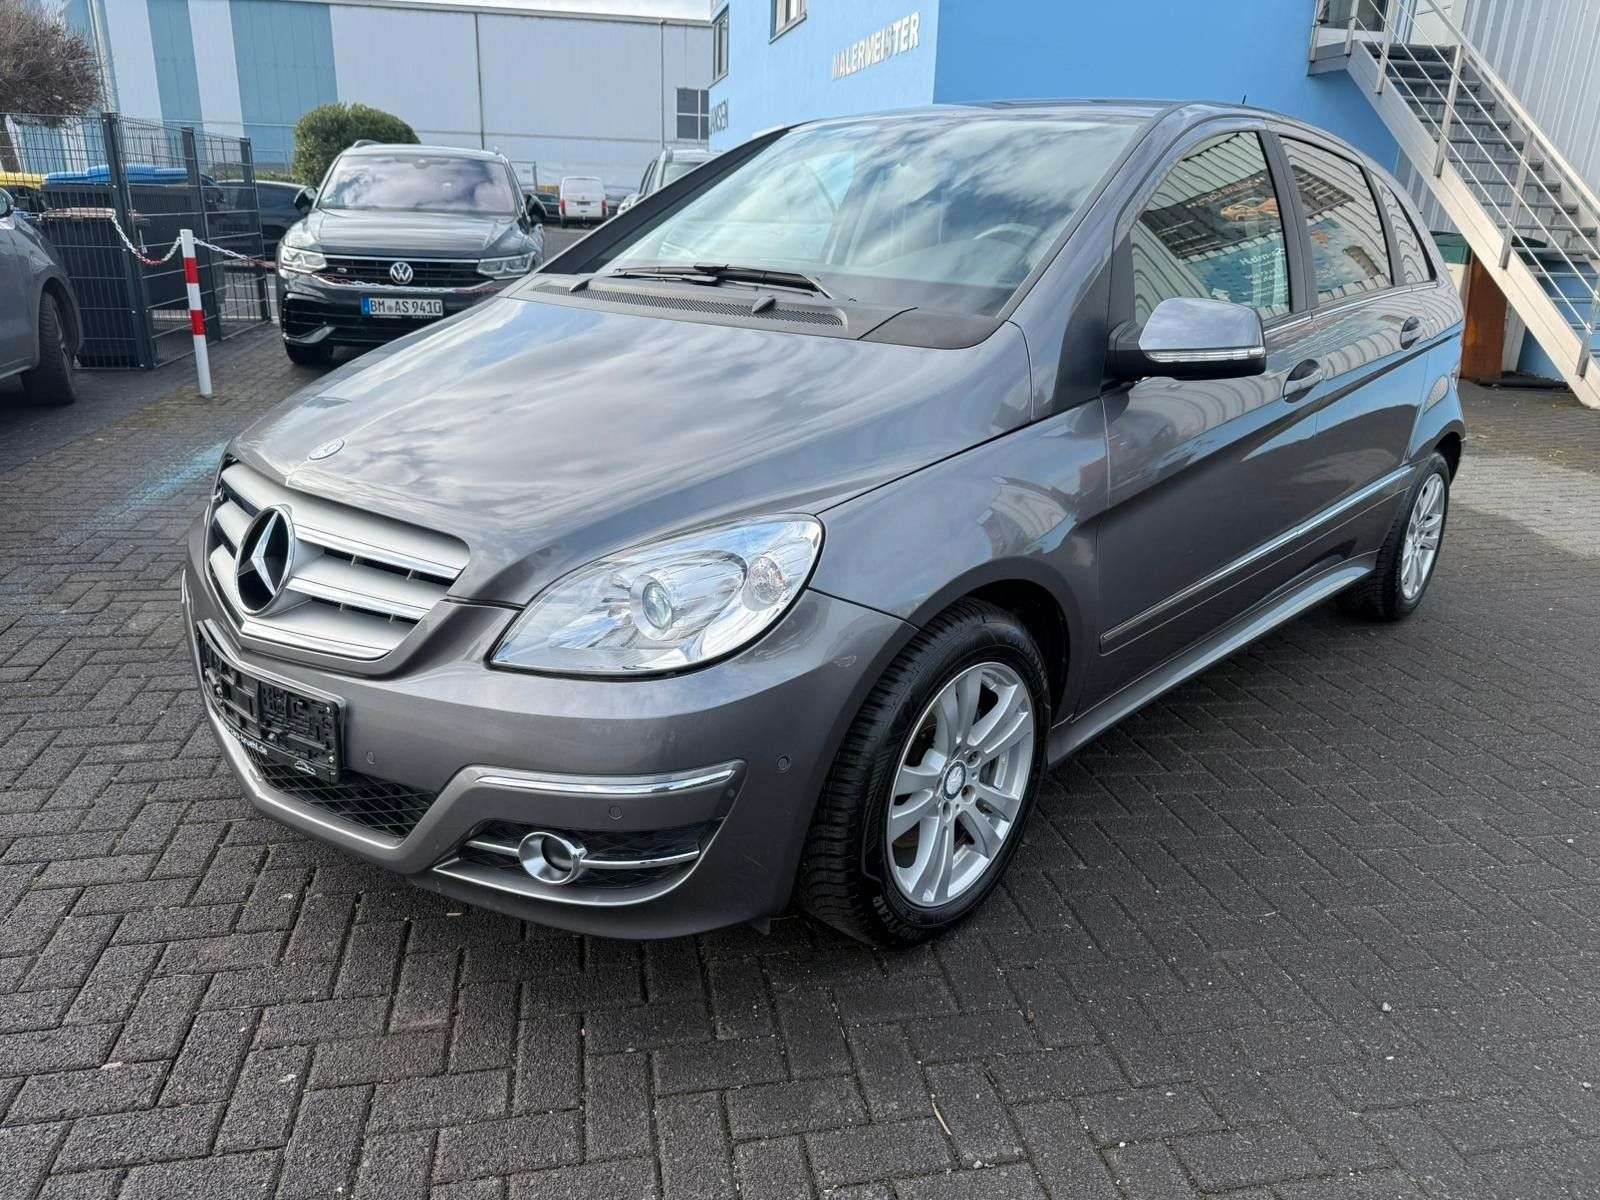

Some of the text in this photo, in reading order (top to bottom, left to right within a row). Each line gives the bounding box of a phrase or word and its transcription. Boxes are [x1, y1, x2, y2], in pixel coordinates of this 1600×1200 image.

[832, 11, 920, 80] MALERMEISTER
[370, 300, 442, 314] BM AS 9410
